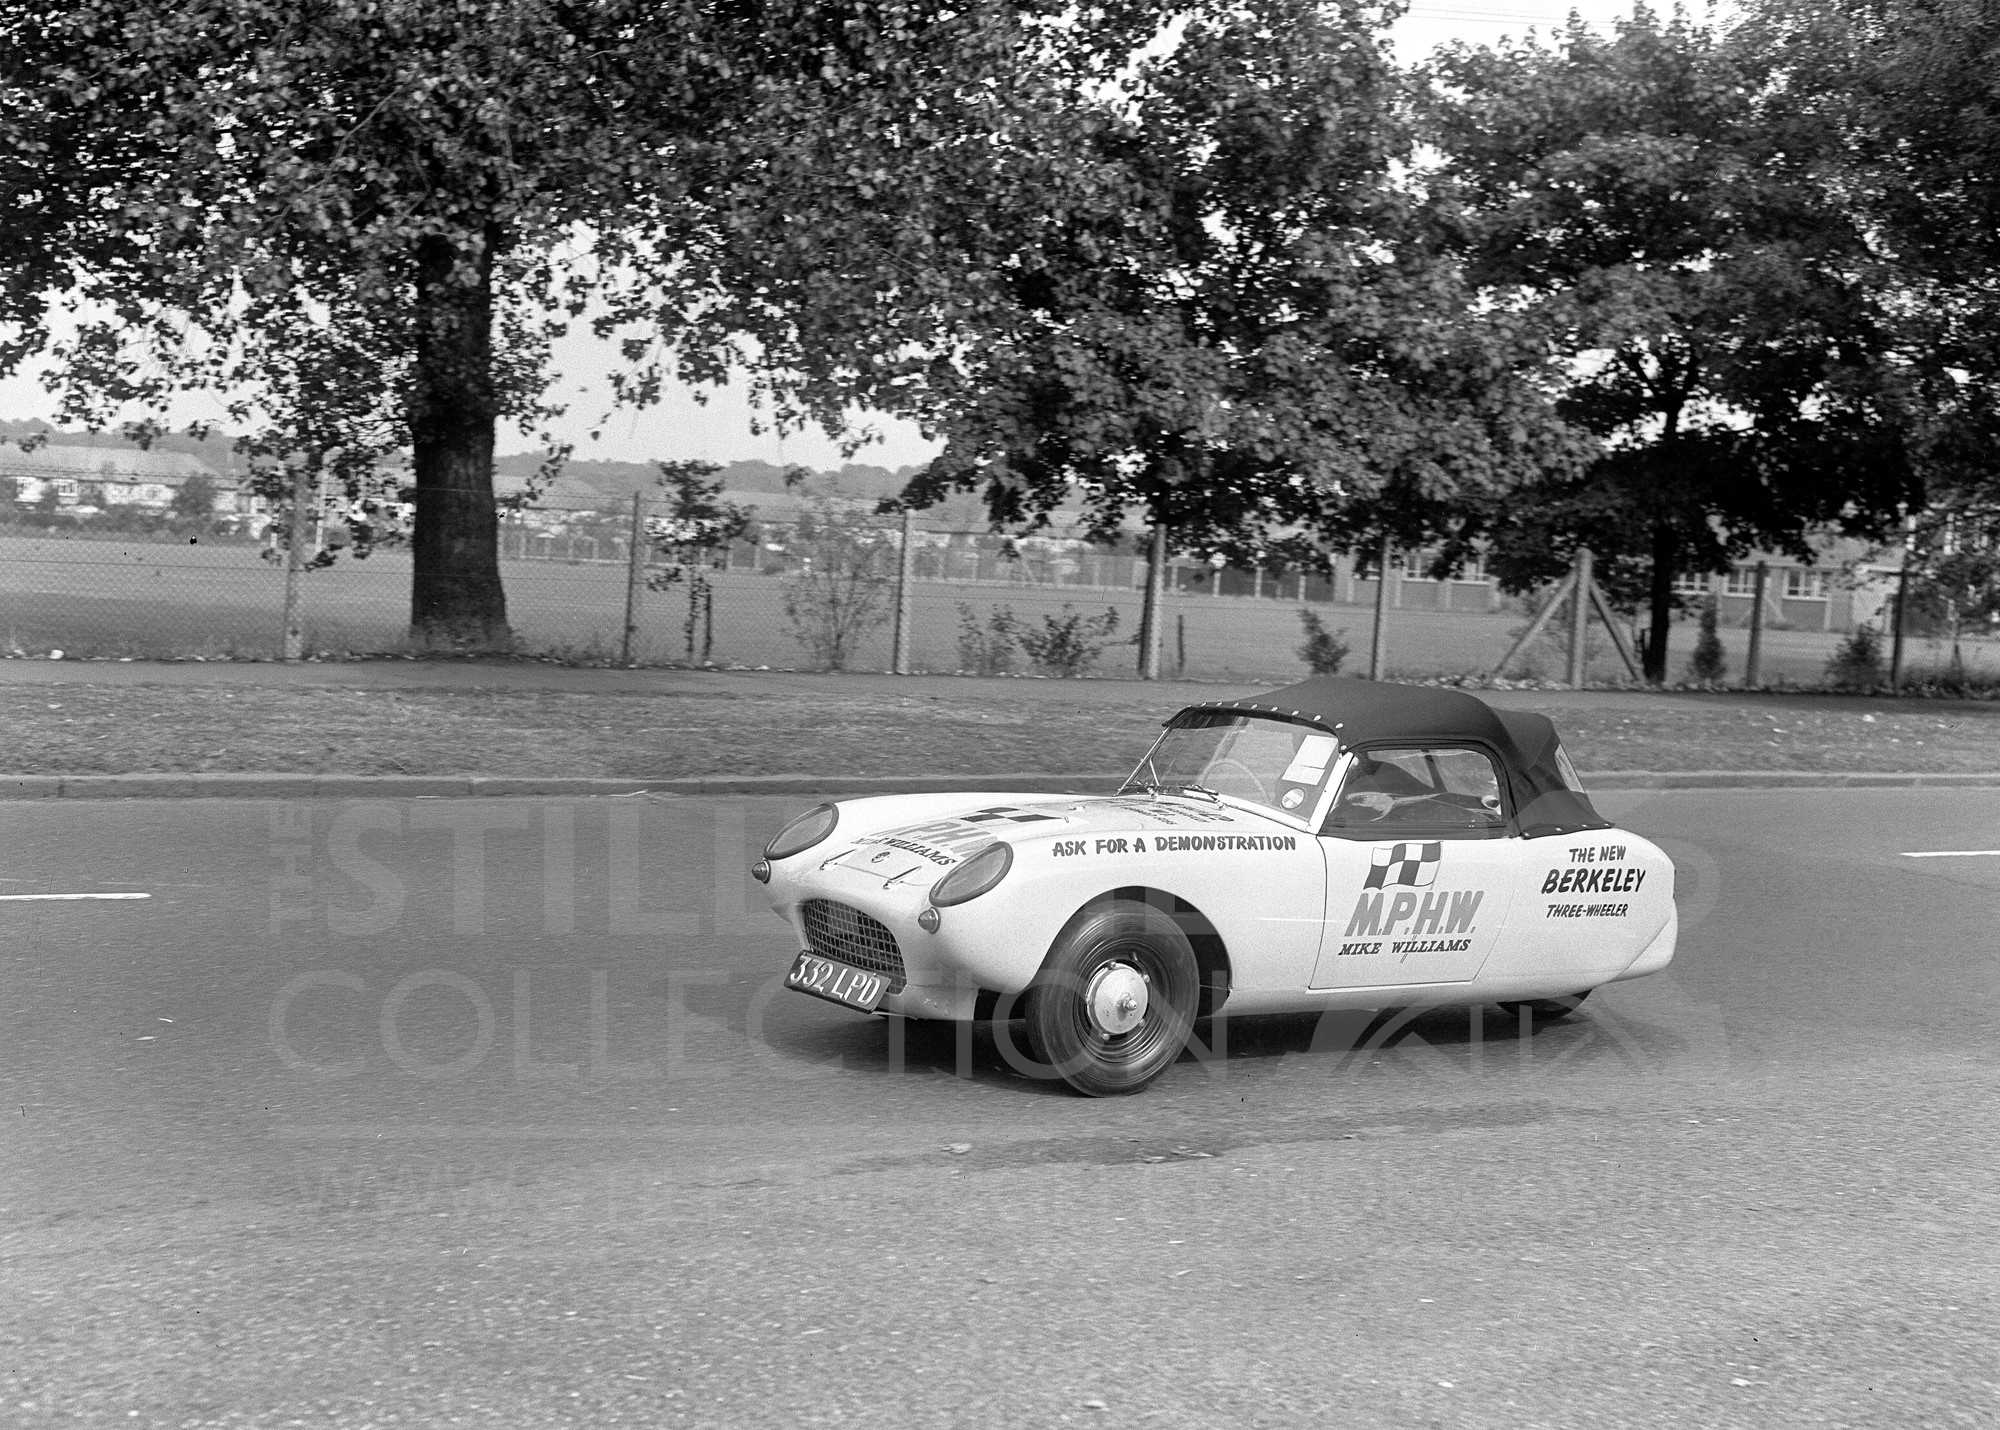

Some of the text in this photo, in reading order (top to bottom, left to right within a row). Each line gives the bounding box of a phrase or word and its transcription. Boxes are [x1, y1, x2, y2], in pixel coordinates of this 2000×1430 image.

[1052, 836, 1297, 857] ASK FOR A DEMONSTRATION
[1568, 845, 1627, 863] THE NEW
[1541, 868, 1646, 895] BERKELEY
[1344, 890, 1485, 937] M.P.H.W.
[1546, 903, 1629, 919] THREE-WHEELER
[1337, 939, 1472, 956] MIKE WILLIAMS
[789, 955, 881, 1006] 332 LPD
